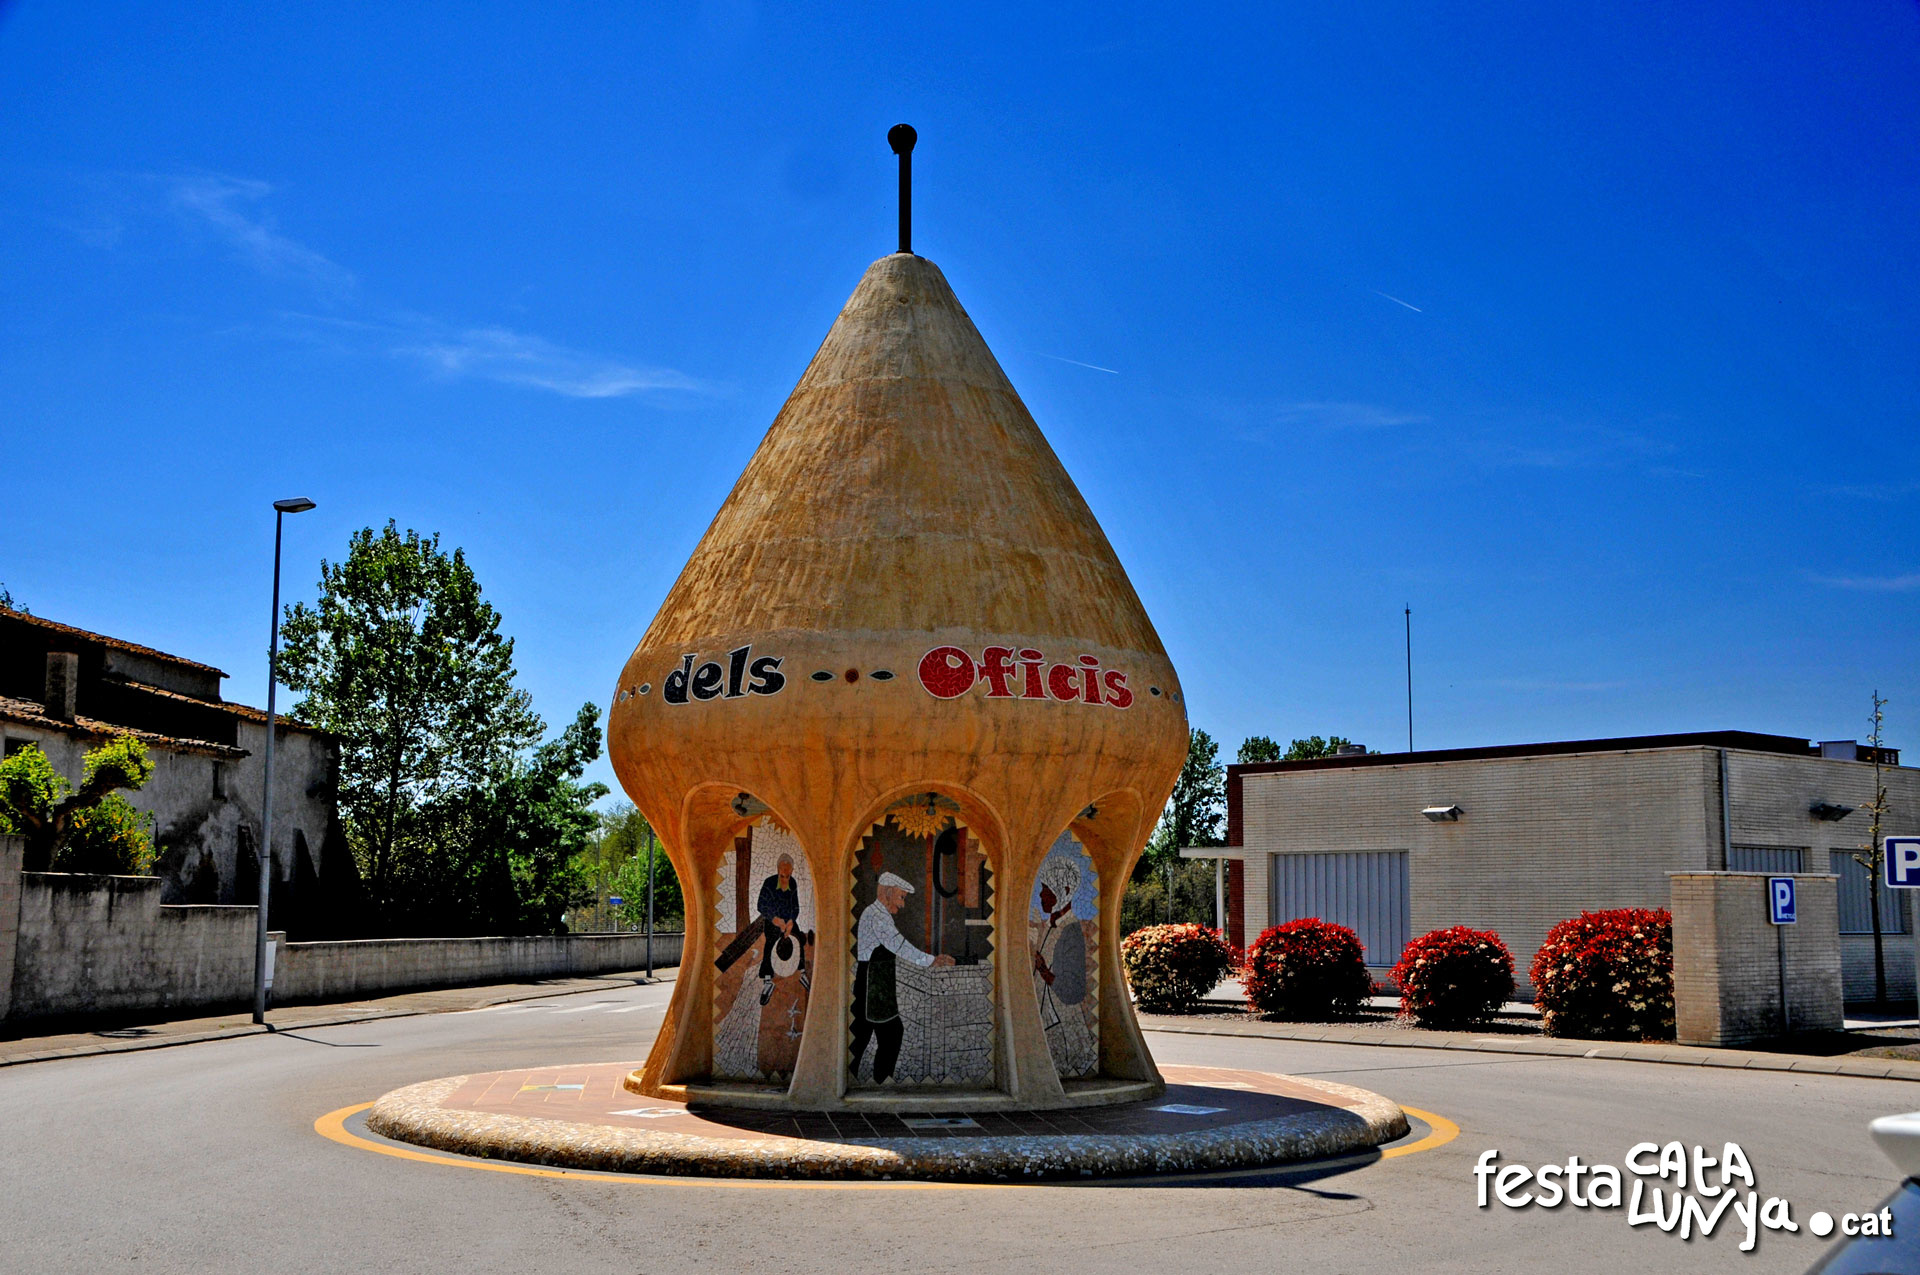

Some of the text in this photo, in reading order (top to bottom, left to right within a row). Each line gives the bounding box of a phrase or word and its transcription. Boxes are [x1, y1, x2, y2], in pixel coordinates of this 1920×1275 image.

[664, 645, 1134, 709] dels Oficis
[1895, 843, 1920, 882] P
[1775, 882, 1791, 919] P
